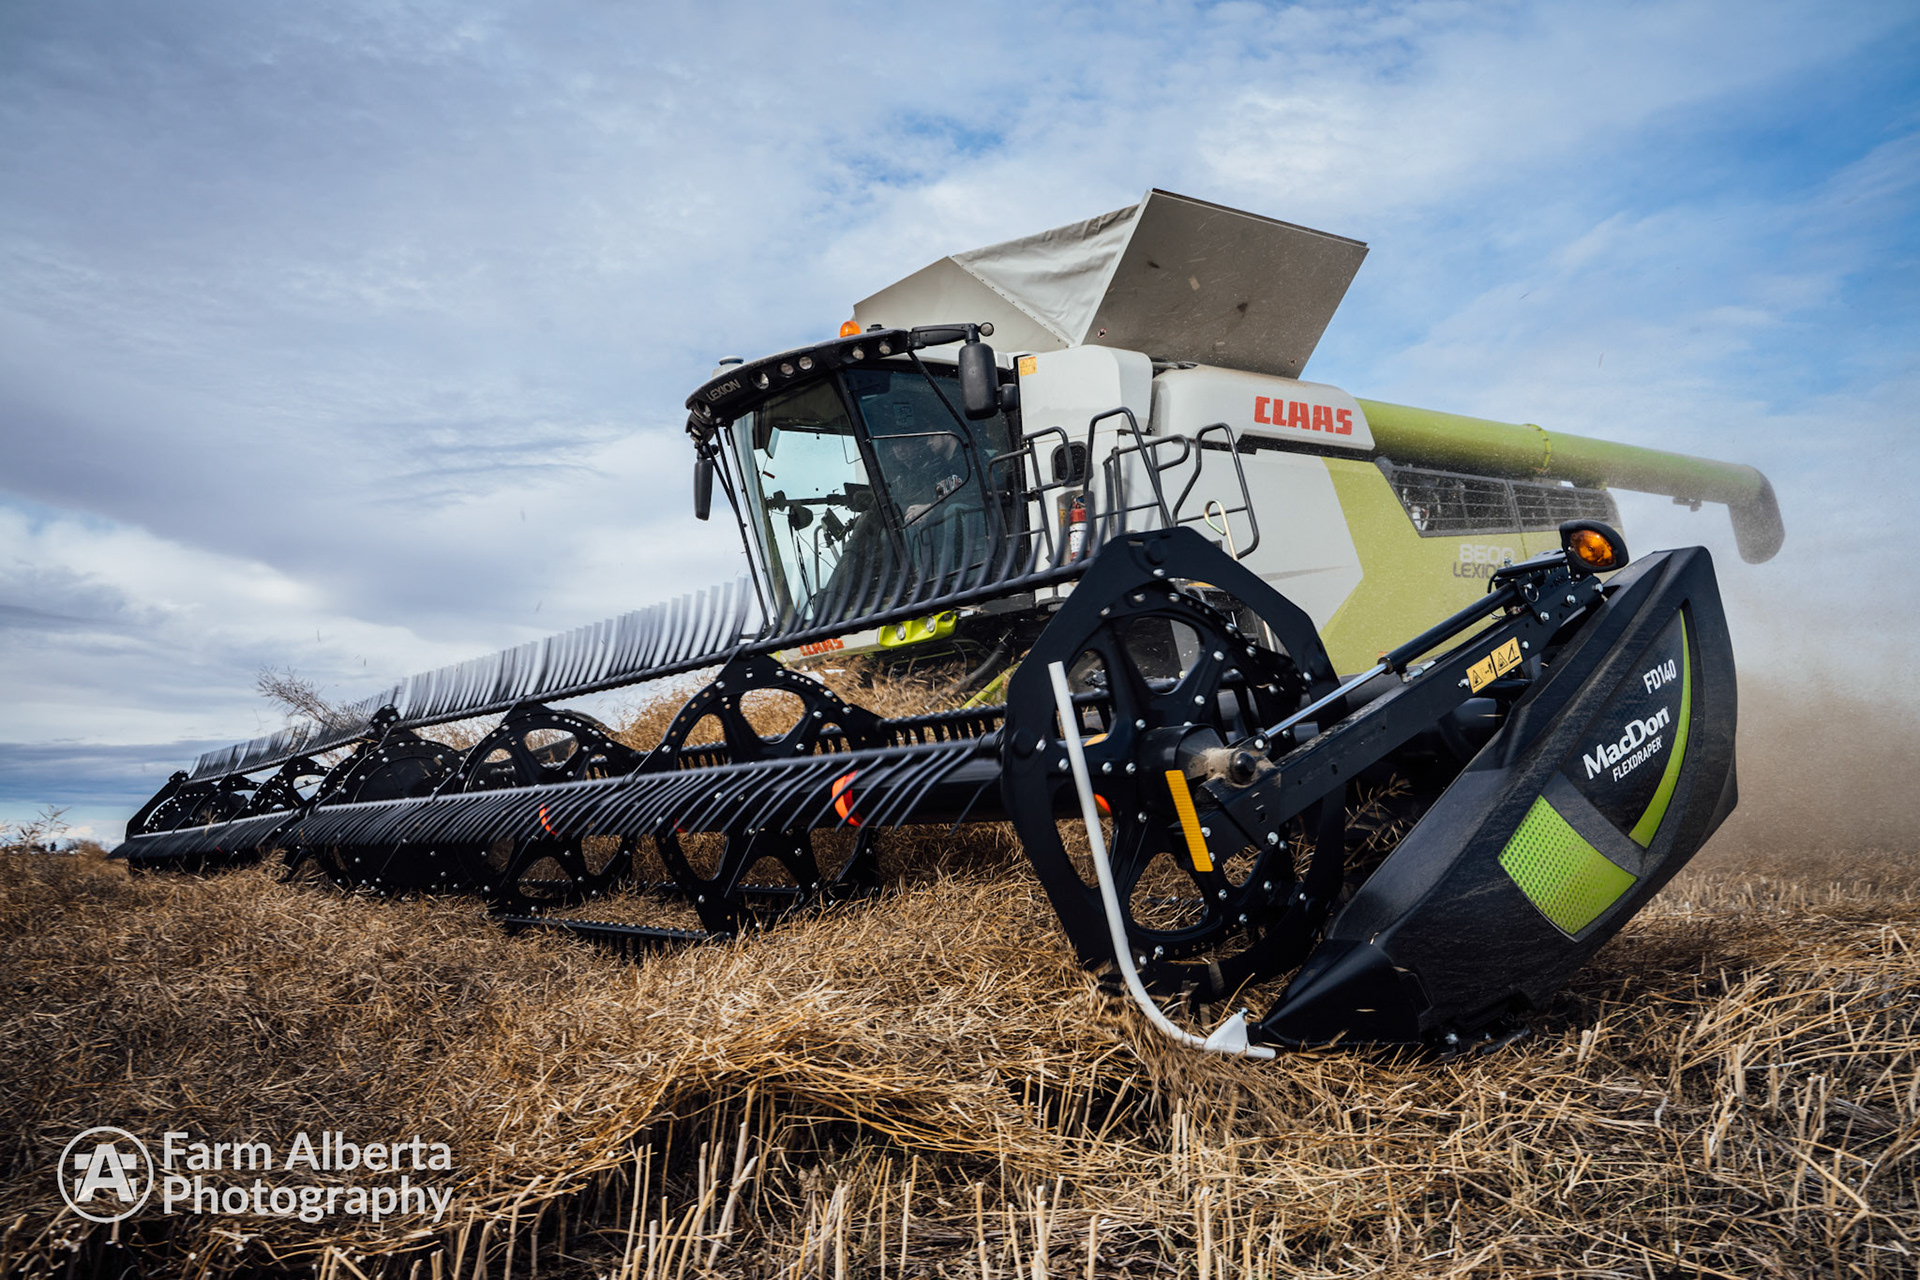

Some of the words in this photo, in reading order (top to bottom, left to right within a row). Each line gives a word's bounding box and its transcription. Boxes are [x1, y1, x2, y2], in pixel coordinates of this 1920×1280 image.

[706, 379, 741, 401] LEXION
[1254, 396, 1352, 435] CLAAS
[1459, 544, 1515, 565] 8600
[1453, 562, 1502, 579] LEXIO
[799, 639, 844, 656] CLAAS
[1643, 659, 1677, 694] FD140
[1582, 707, 1670, 780] MacDon
[1612, 737, 1662, 782] FLEXDRAPER
